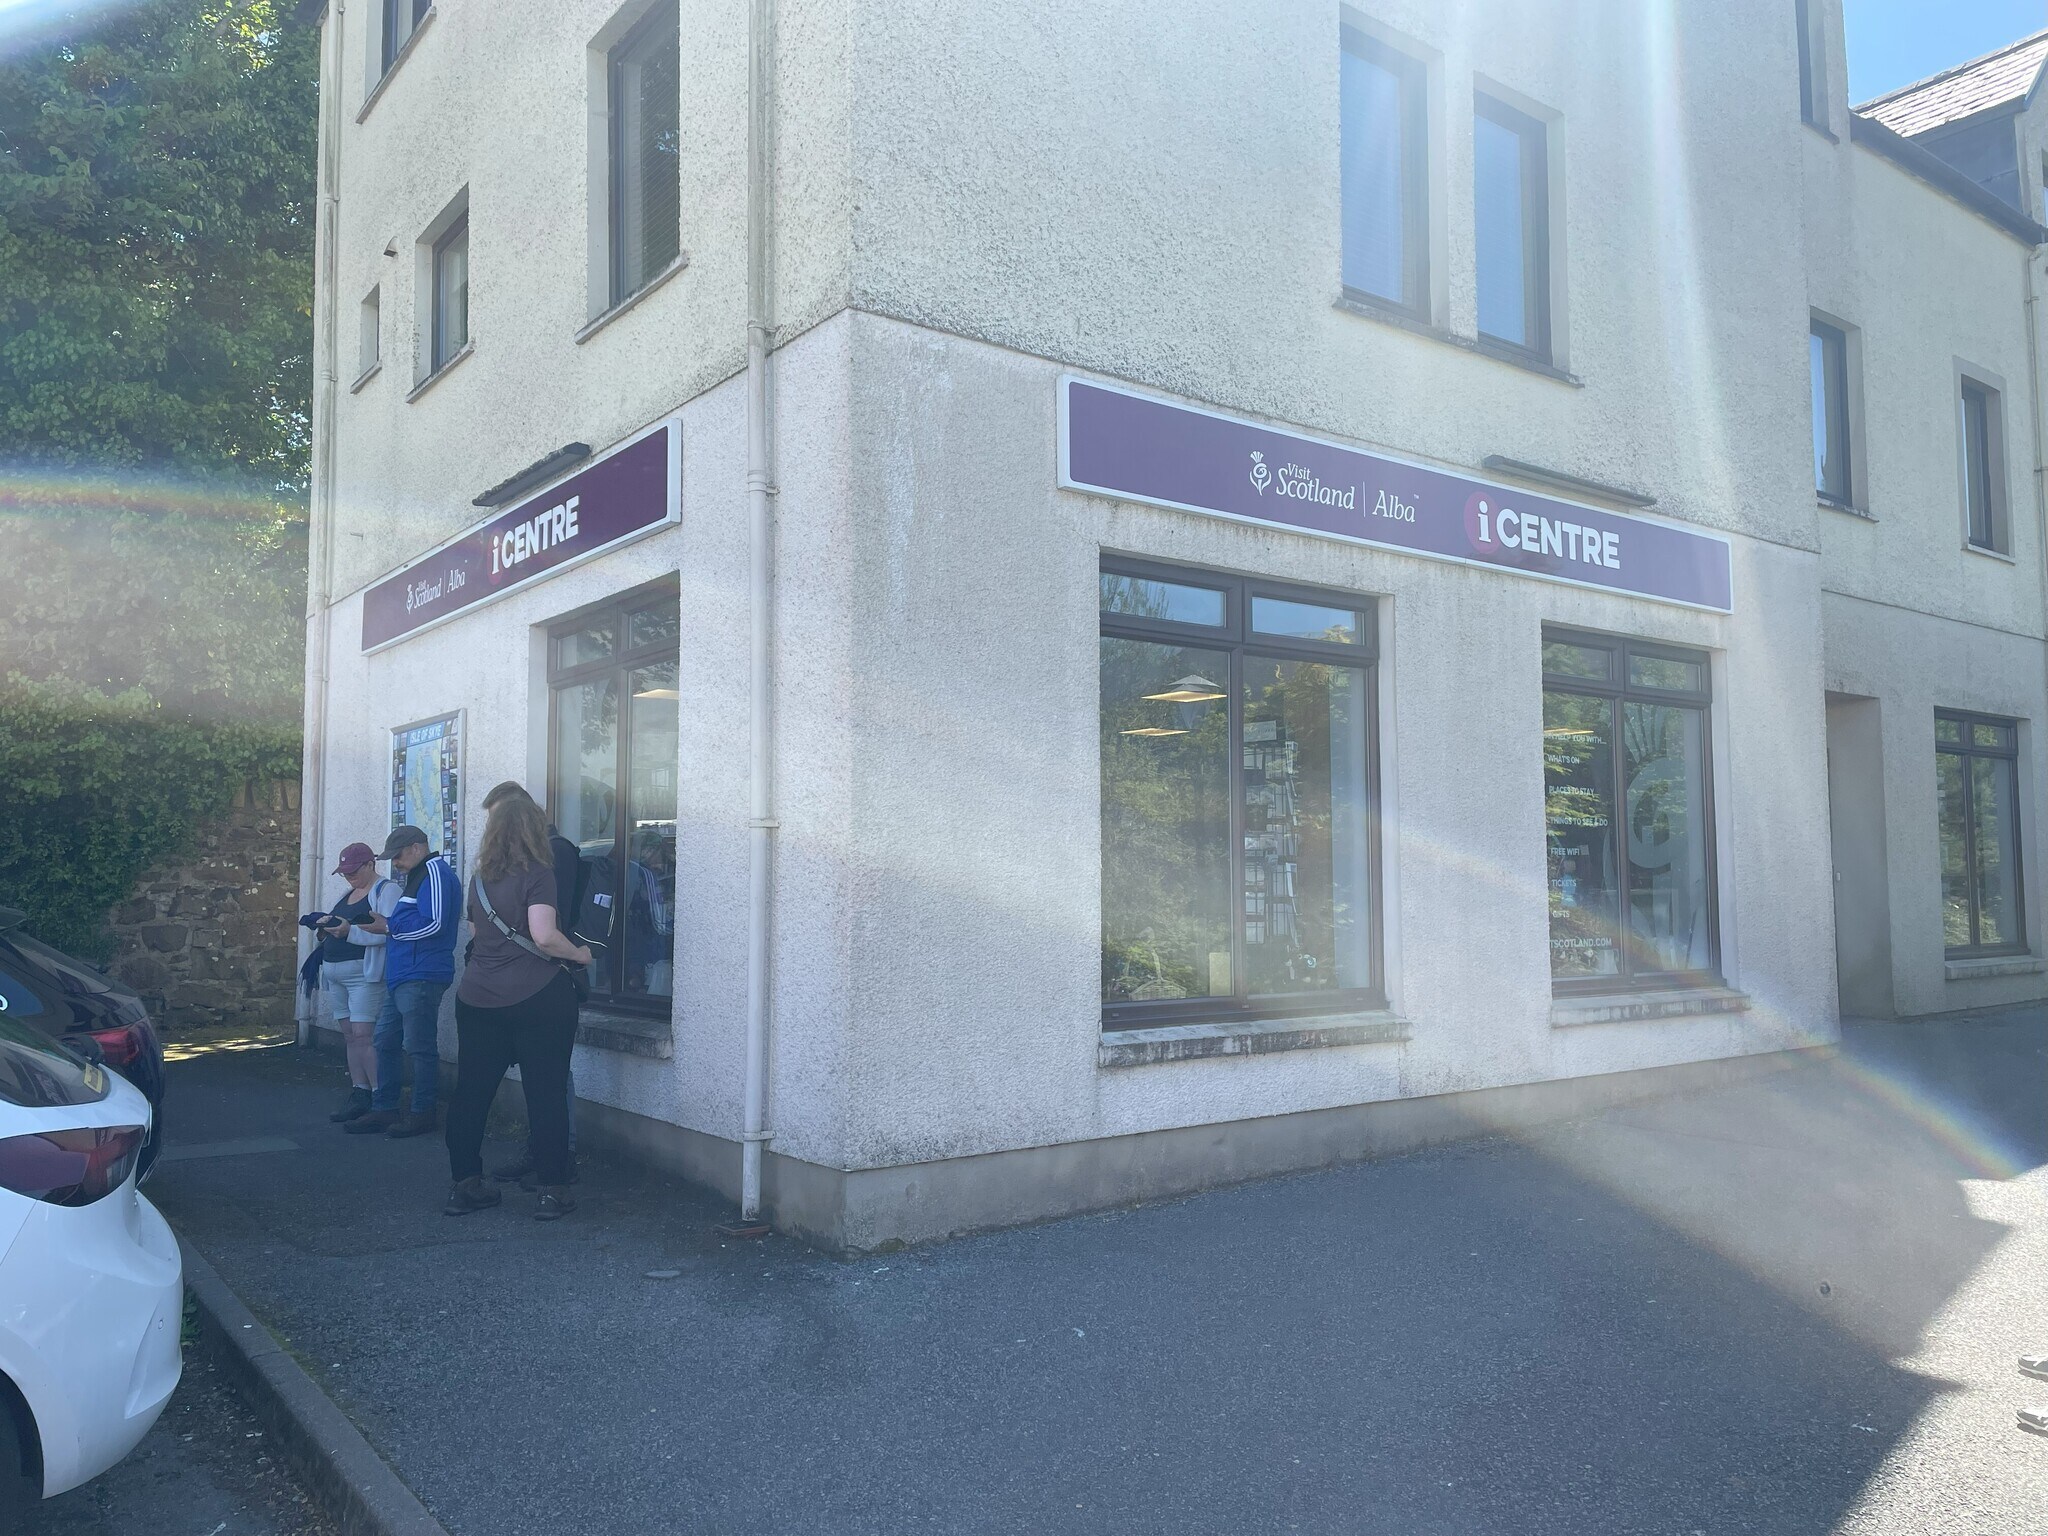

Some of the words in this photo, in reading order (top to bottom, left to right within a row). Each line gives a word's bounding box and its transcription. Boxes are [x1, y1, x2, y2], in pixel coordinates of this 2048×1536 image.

[1287, 462, 1311, 481] Visit
[1276, 467, 1356, 510] Scotland
[1372, 490, 1416, 523] Alba
[413, 577, 442, 609] Scotland
[446, 568, 466, 593] Alba
[1570, 756, 1580, 765] ON
[1548, 785, 1571, 795] PLACES
[1570, 786, 1580, 795] TO
[1580, 787, 1595, 797] STAY
[1550, 816, 1572, 825] THINGS
[1572, 817, 1582, 826] TO
[1582, 817, 1594, 827] SEE
[1599, 818, 1609, 827] DO
[1551, 847, 1567, 856] FREE
[1567, 847, 1580, 856] WIFI
[1551, 878, 1577, 887] TICKETS
[1552, 910, 1570, 918] GIFTS
